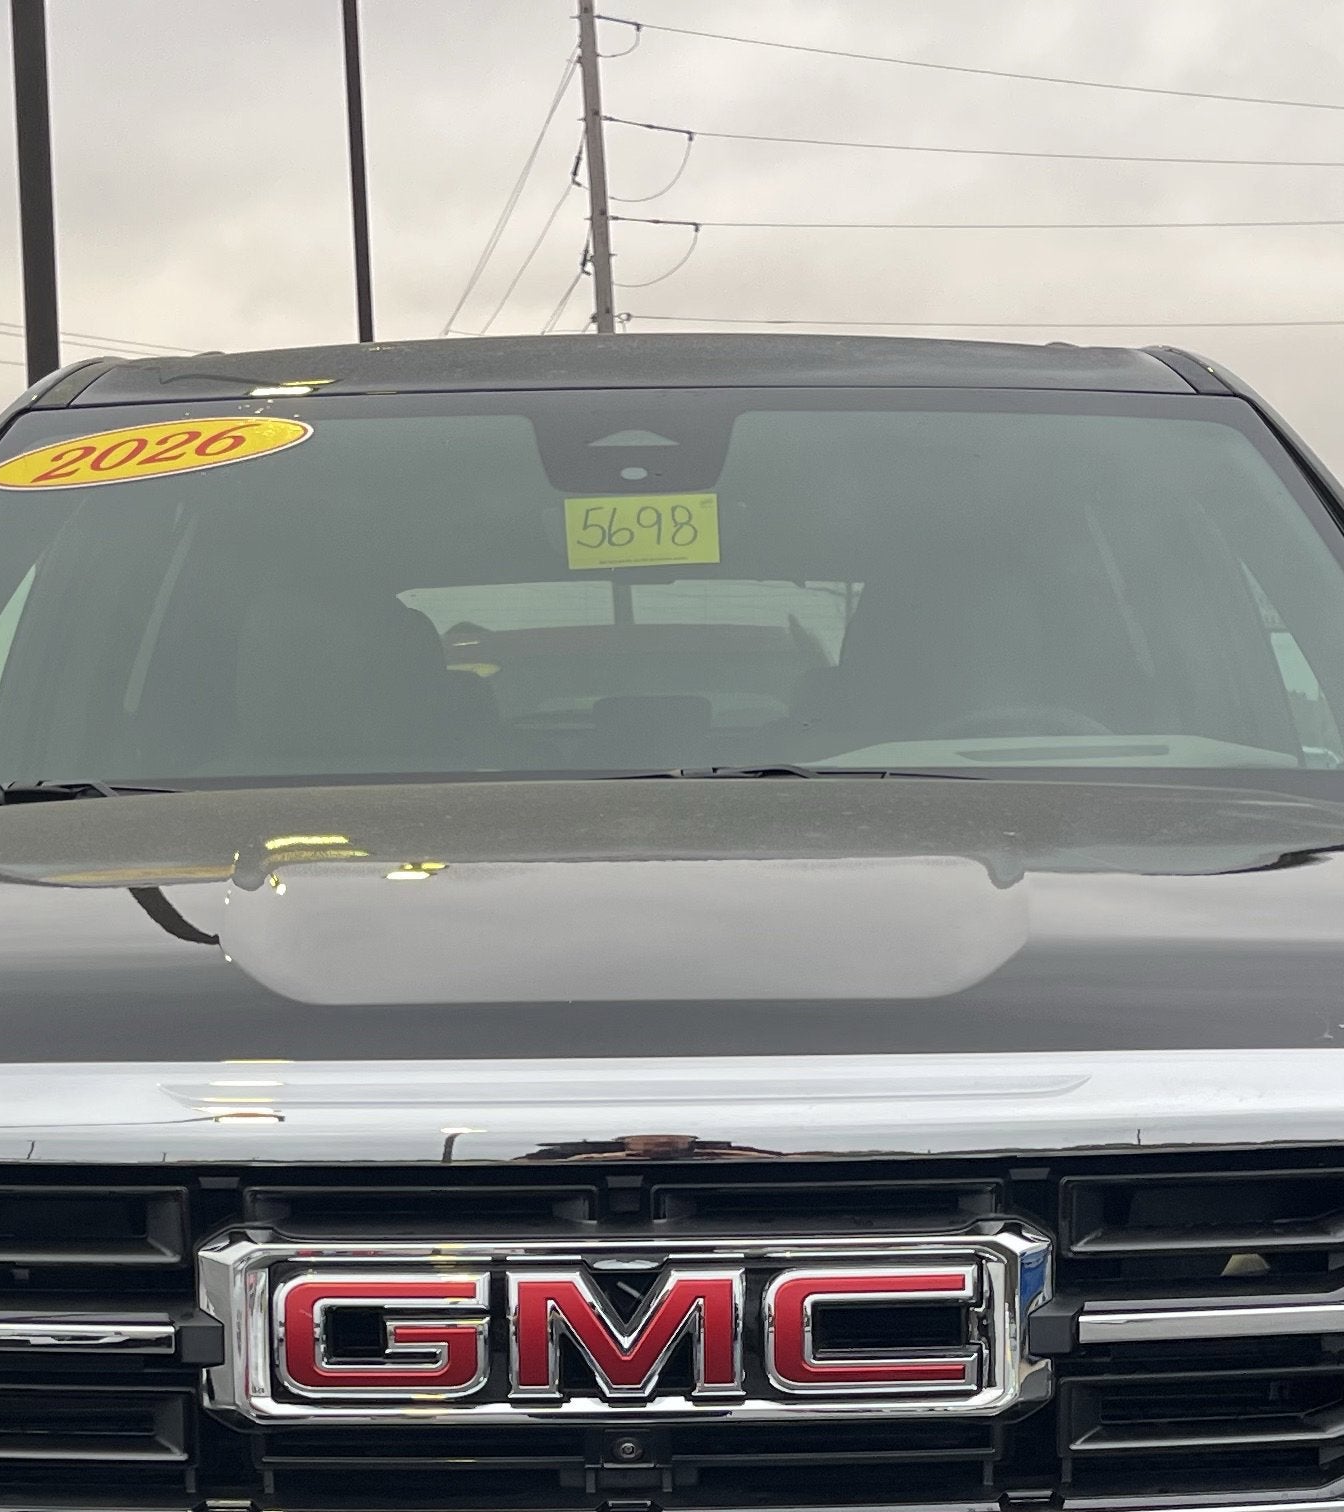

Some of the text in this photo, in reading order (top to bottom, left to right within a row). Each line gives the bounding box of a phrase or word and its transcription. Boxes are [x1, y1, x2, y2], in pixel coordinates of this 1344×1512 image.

[30, 423, 262, 484] 2026
[576, 504, 698, 549] 5698
[275, 1267, 979, 1398] GMC
